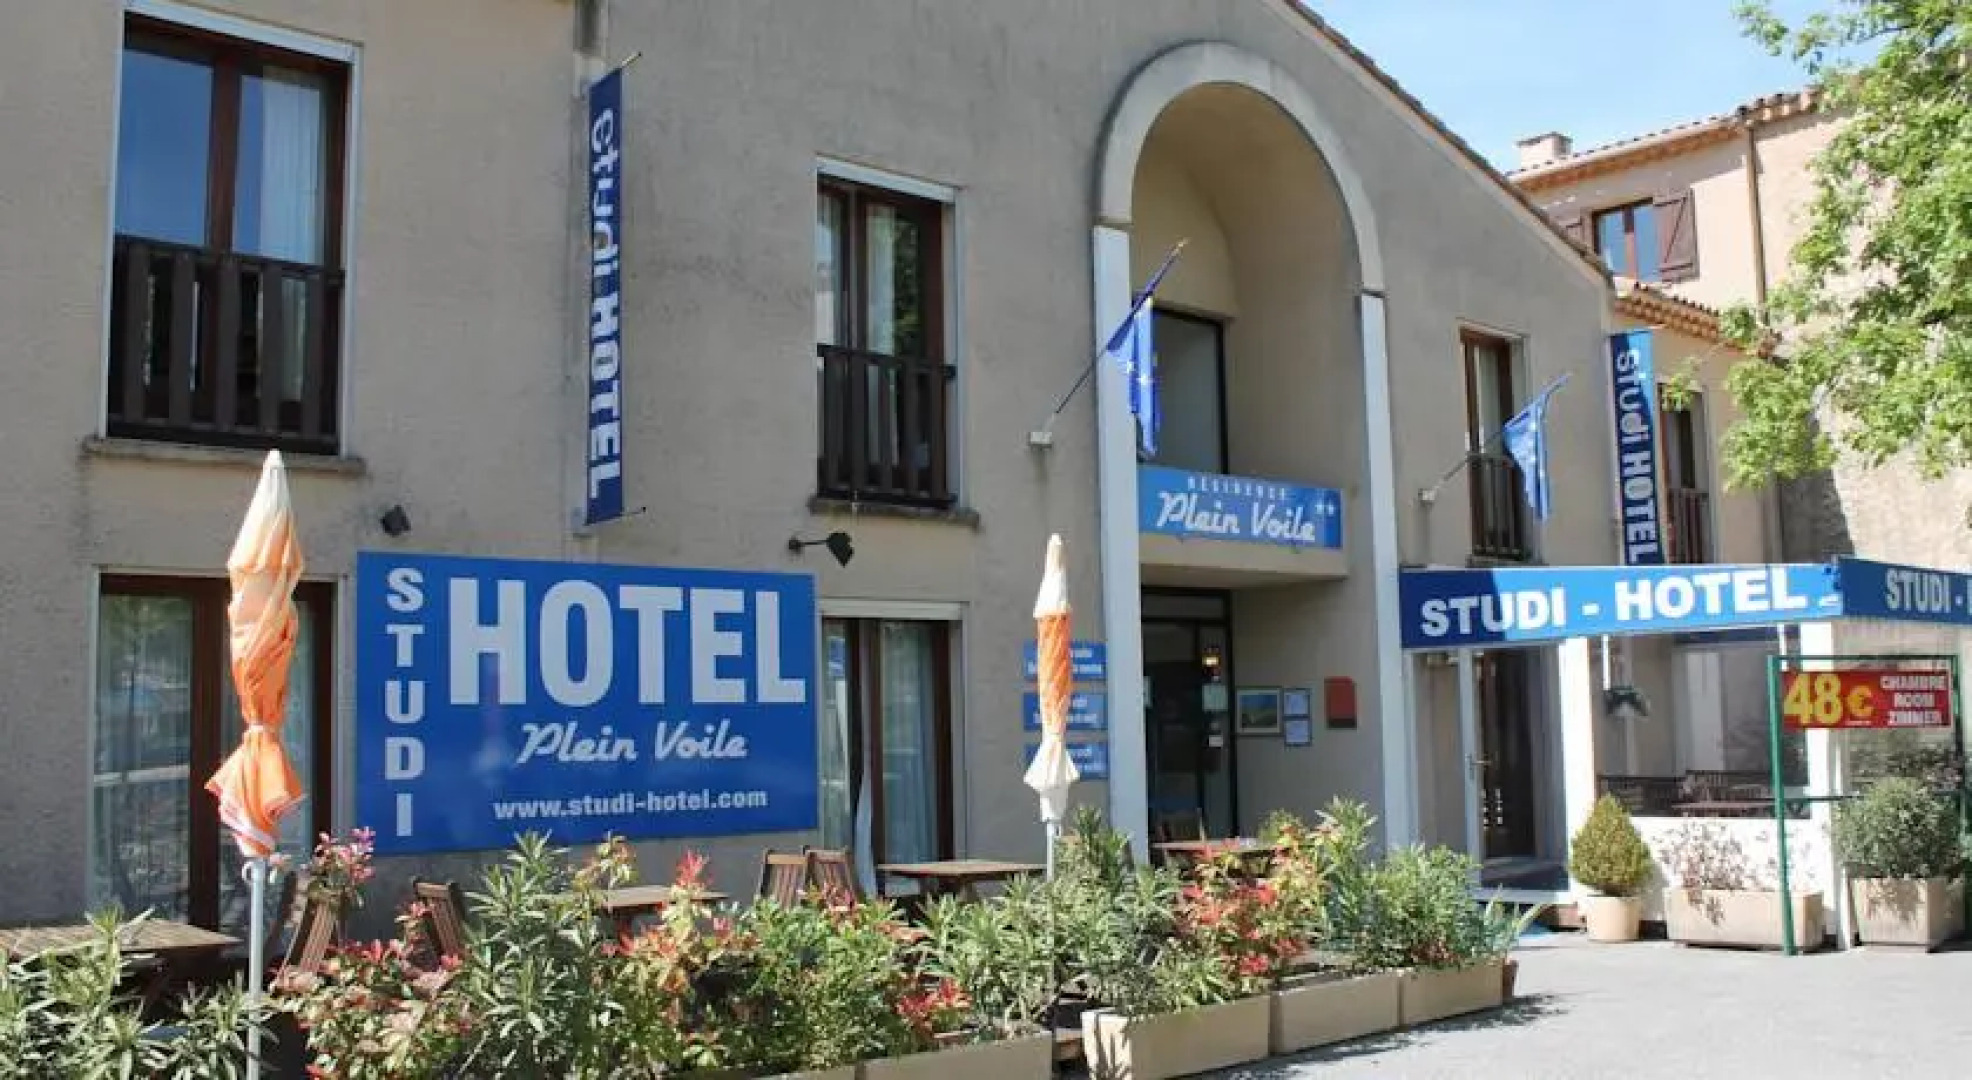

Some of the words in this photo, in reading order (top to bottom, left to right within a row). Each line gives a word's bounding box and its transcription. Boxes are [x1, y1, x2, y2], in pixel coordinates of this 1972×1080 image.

[590, 290, 620, 498] HOTEL
[1616, 348, 1649, 445] studi
[1156, 490, 1240, 534] Plein
[1252, 501, 1316, 541] Voile
[1622, 451, 1658, 564] HOTEL
[1420, 584, 1567, 637] STUDI
[1614, 567, 1809, 621] HOTEL
[1886, 567, 1950, 613] STUDI
[449, 577, 806, 707] HOTEL
[385, 567, 425, 837] STUDI
[1880, 674, 1946, 690] CHAMBRE
[1893, 692, 1936, 708] ROOM
[516, 721, 637, 765] Plein
[655, 718, 749, 761] Voile
[1887, 710, 1943, 726] ZIMMER
[494, 788, 768, 821] www.studi-hotel.com
